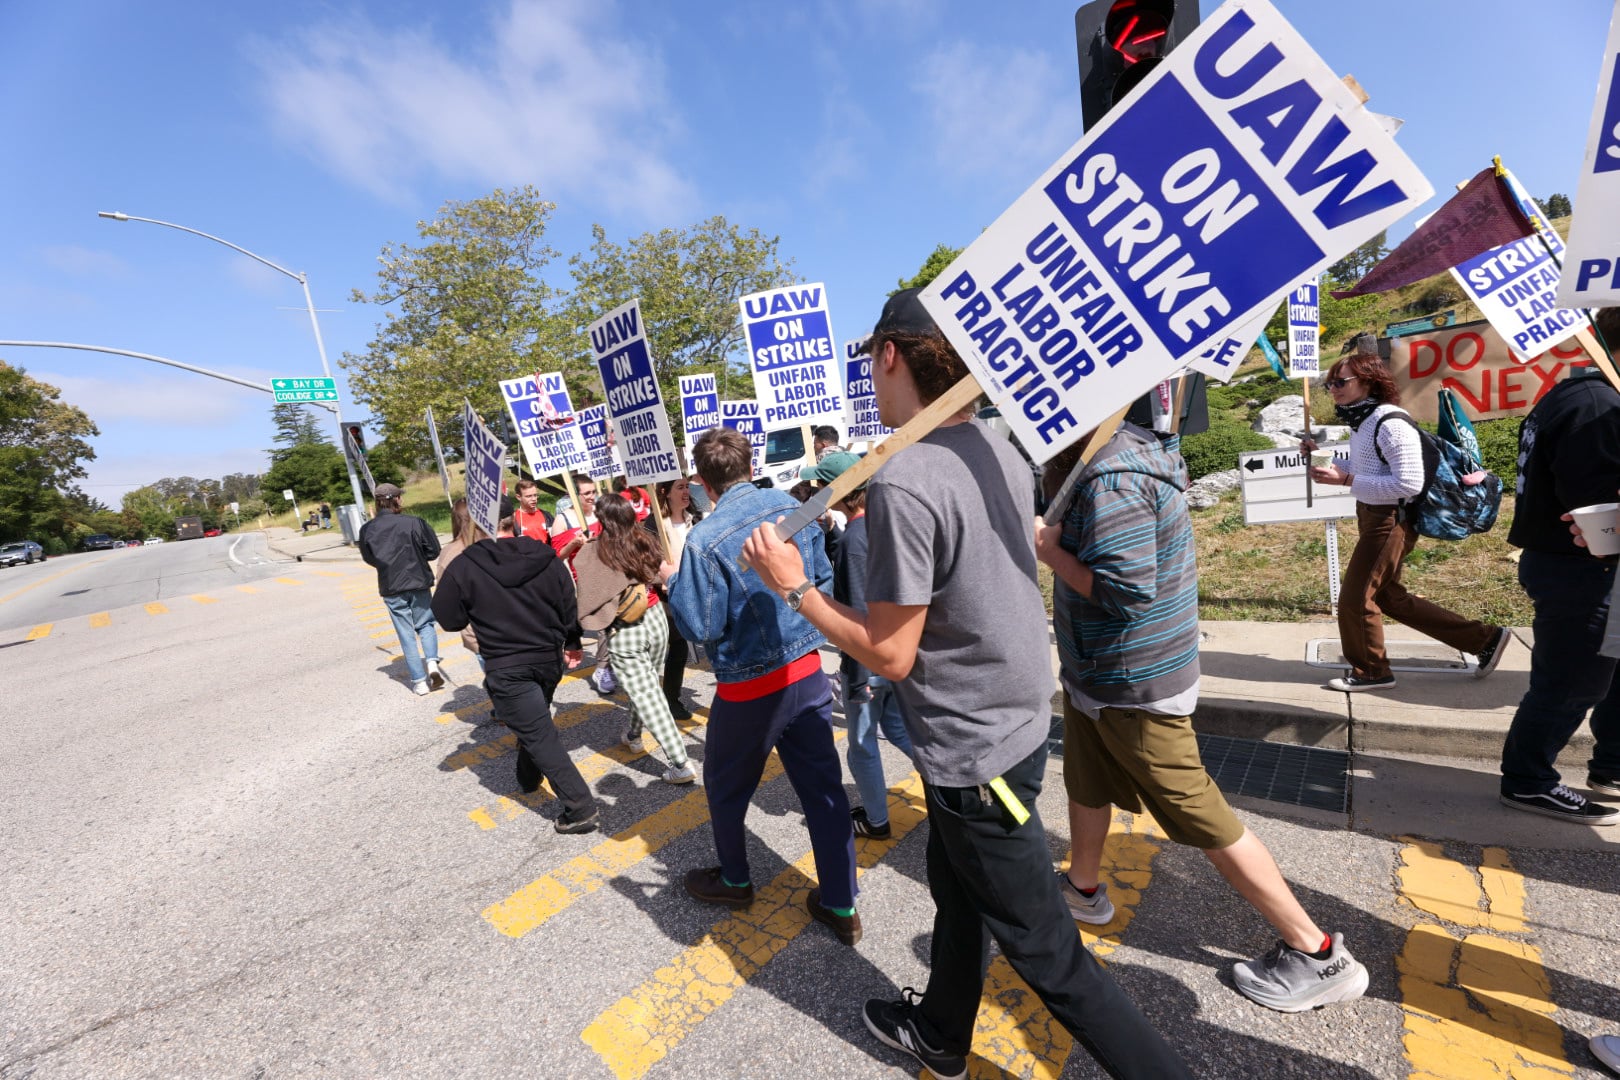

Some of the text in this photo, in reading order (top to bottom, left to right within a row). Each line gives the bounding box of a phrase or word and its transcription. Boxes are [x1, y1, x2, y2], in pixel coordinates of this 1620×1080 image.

[1194, 8, 1409, 231] UAW
[1161, 148, 1259, 244] ON
[1065, 153, 1231, 342] STRIKE
[1468, 230, 1560, 290] STRIKE
[1026, 222, 1143, 368] UNFAIR
[1297, 286, 1310, 303] ON
[1498, 263, 1561, 308] UNFAI
[745, 288, 821, 319] UAW
[1290, 304, 1318, 322] STRIKE
[591, 307, 638, 354] UAW
[773, 318, 804, 340] ON
[991, 262, 1096, 391] LABOR
[1294, 330, 1315, 342] UNFAIR
[756, 337, 830, 367] STRIKE
[940, 269, 1078, 445] PRACTICE
[1296, 344, 1314, 356] LABOR
[1410, 332, 1485, 379] DO
[613, 352, 633, 381] ON
[1292, 358, 1317, 371] PRACTICE
[292, 380, 325, 388] BAY DR
[682, 377, 714, 394] UAW
[768, 365, 826, 387] UNFAIR
[277, 391, 325, 400] COOLIDGE DR
[609, 376, 656, 412] STRIKE
[774, 381, 827, 403] LABOR
[694, 397, 709, 413] ON
[765, 396, 842, 422] PRACTICE
[853, 398, 879, 411] UNFA
[620, 411, 657, 437] UNFAIR
[686, 412, 719, 430] STRIKE
[736, 420, 753, 432] ON
[855, 411, 880, 424] LABO
[466, 404, 503, 460] UAW
[532, 430, 573, 448] UNFAIR
[587, 423, 600, 436] ON
[539, 443, 576, 460] LABOR
[586, 434, 607, 449] TRIK
[626, 433, 661, 457] LABOR
[471, 441, 485, 467] ON
[534, 452, 588, 474] PRACTICE
[592, 456, 614, 469] LABOR
[625, 452, 677, 478] PRACTICE
[589, 464, 622, 479] PRACTICE
[1317, 956, 1350, 980] HOKA
